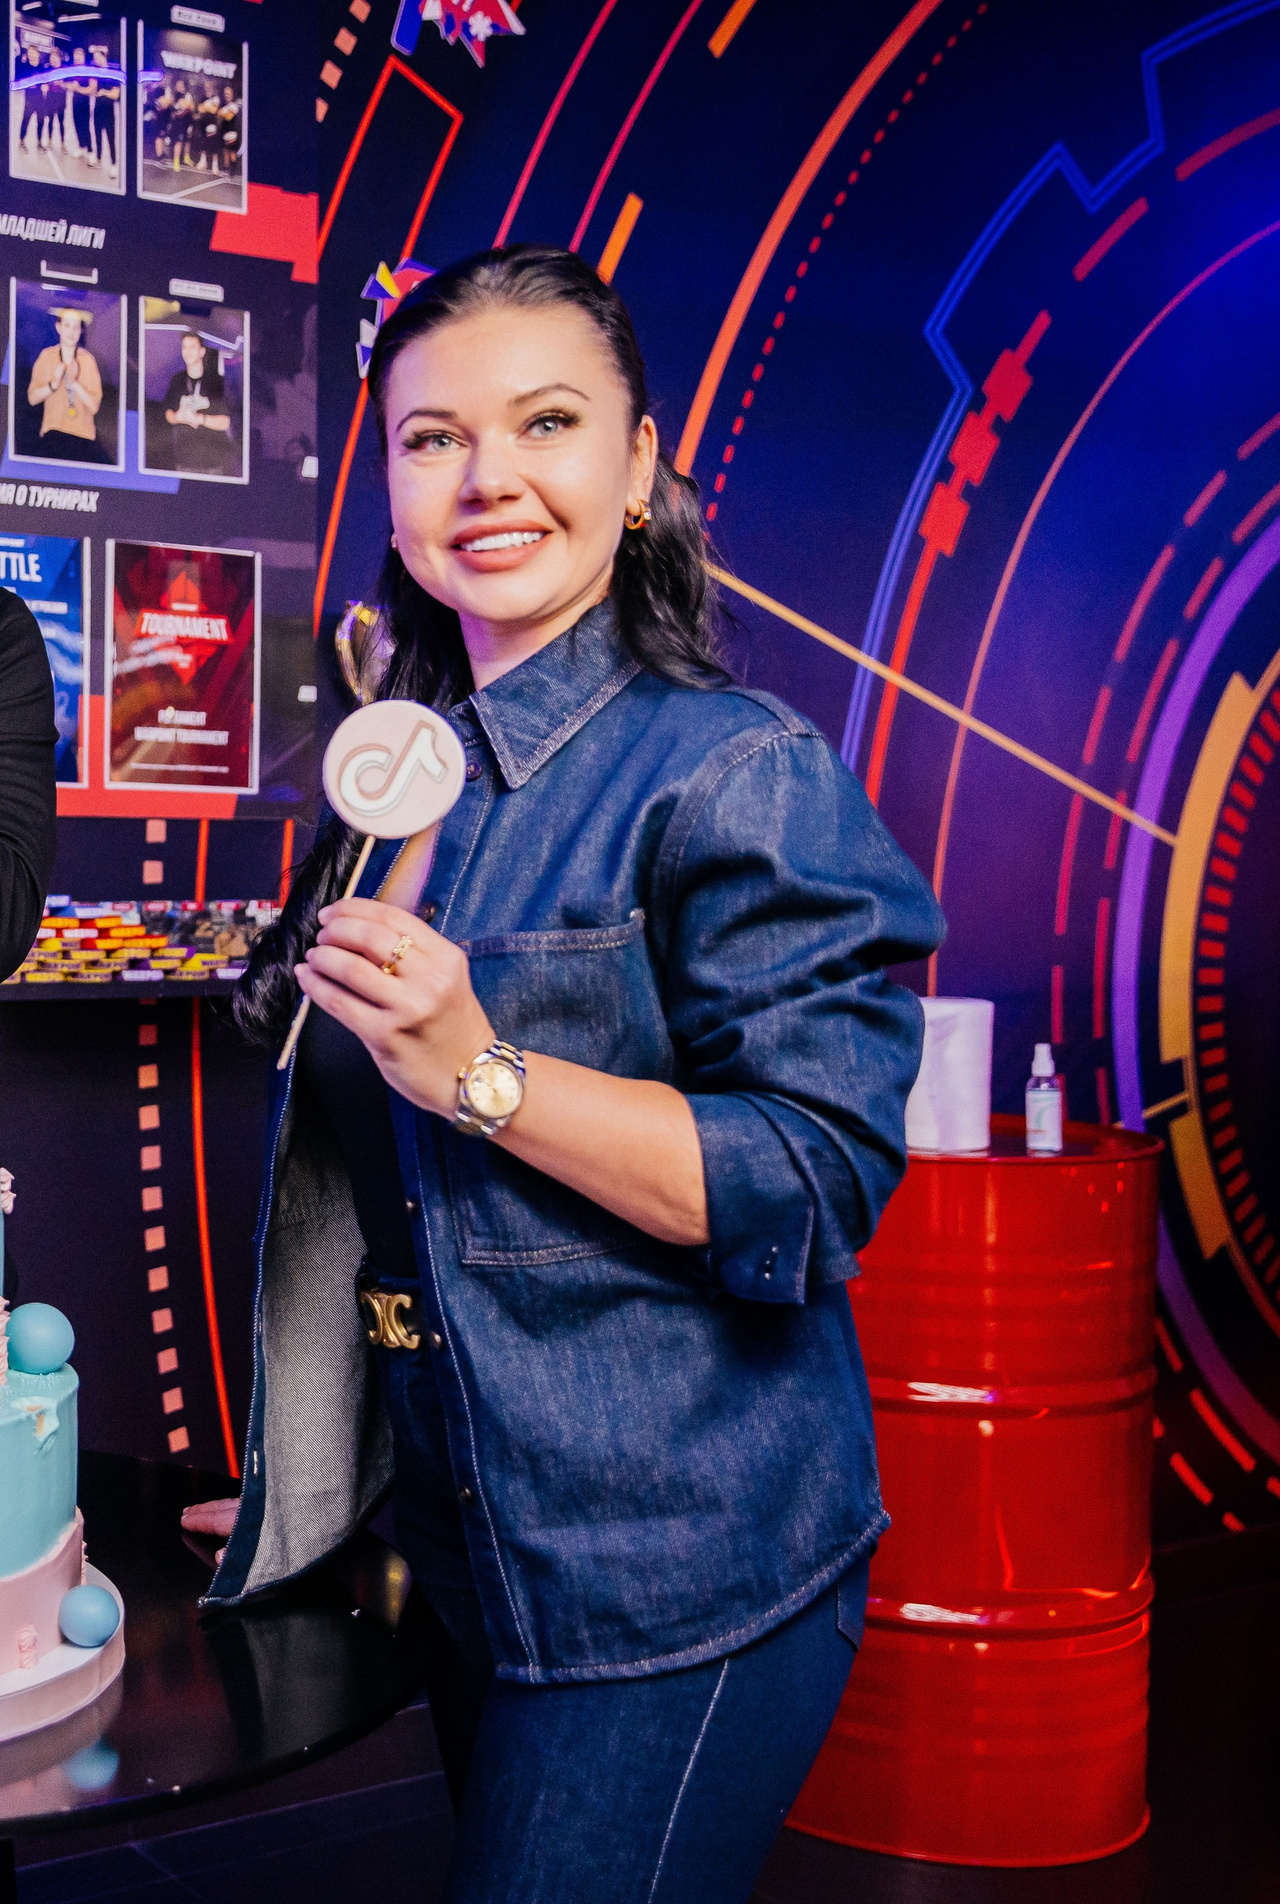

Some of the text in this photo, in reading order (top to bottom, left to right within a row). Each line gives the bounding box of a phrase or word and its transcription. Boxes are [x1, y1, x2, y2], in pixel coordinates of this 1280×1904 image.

[65, 224, 107, 250] ЛИГИ
[16, 484, 28, 507] О
[28, 485, 100, 513] ТУРНИРАХ
[140, 612, 229, 641] TOURNAMENT
